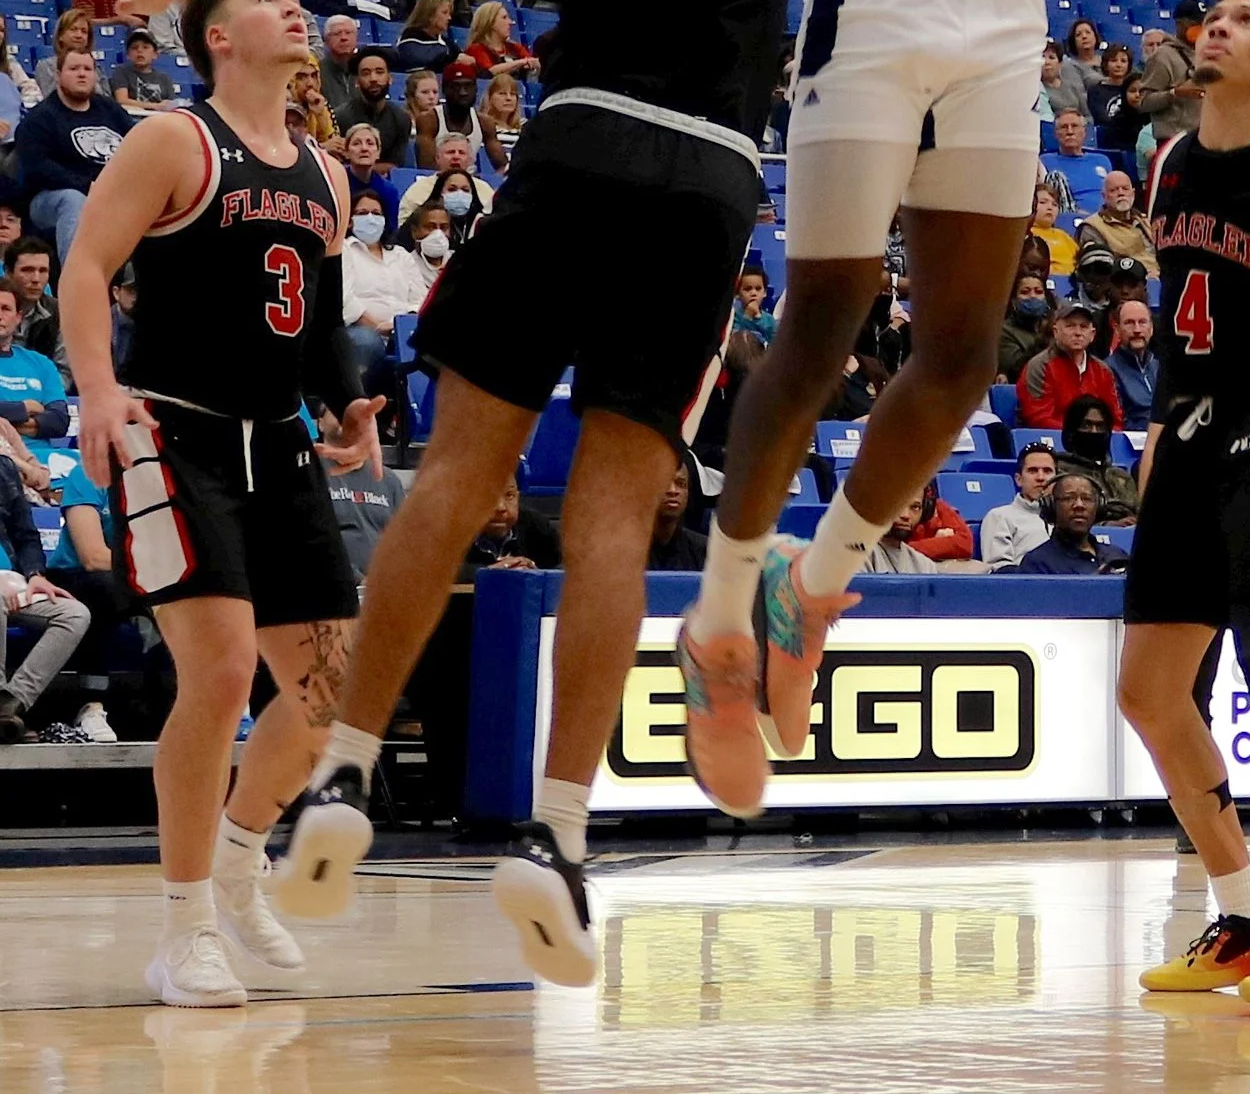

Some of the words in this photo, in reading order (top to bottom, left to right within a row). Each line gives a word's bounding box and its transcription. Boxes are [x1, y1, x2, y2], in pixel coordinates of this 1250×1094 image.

[220, 188, 337, 247] FLAGLER
[264, 243, 305, 337] 3
[1174, 268, 1214, 355] 4
[622, 664, 1020, 764] EGO
